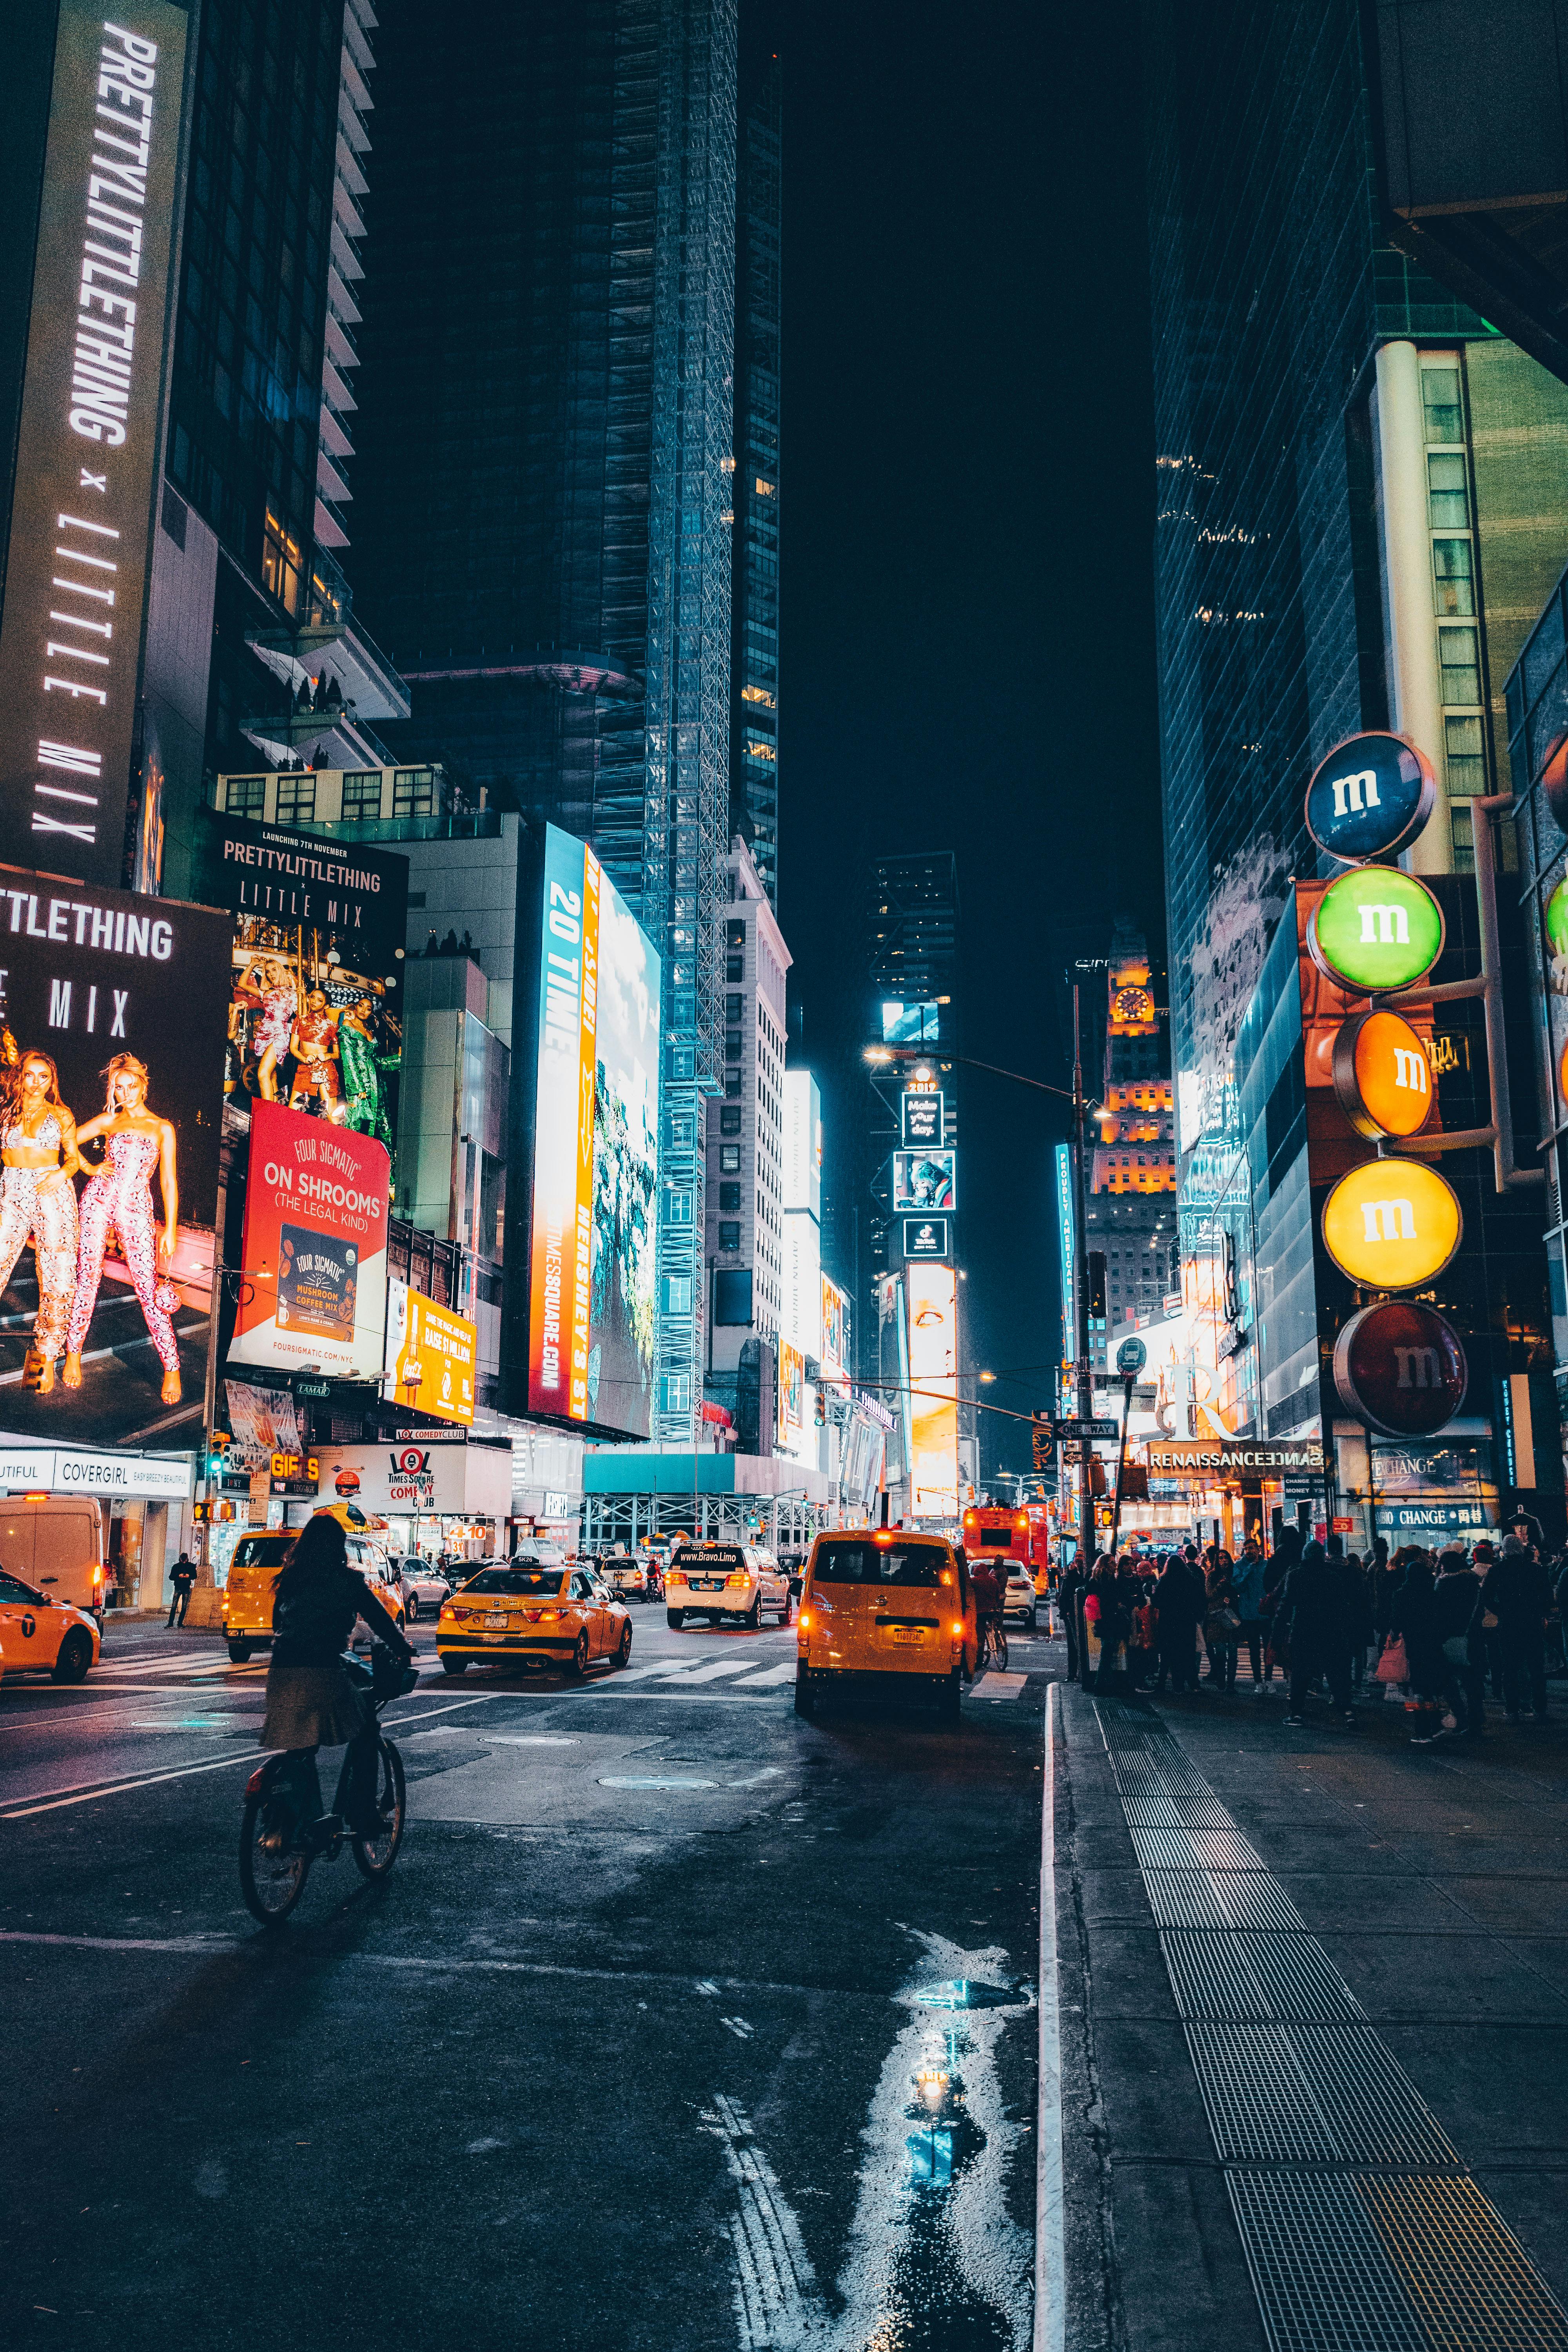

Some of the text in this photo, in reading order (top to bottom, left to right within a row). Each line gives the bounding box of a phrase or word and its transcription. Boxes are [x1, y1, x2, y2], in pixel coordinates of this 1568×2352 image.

[68, 22, 157, 446] PRETTYLITTLETHING
[44, 514, 120, 705] LITTLE
[31, 739, 101, 843] MIX
[1332, 770, 1381, 817] m
[263, 831, 347, 858] LAUNCHING 7TH NOVEMBER
[224, 840, 380, 893] PRETTYLITTLETHING
[240, 881, 361, 928] LITTLE MIX
[0, 889, 173, 960] TLETHING
[1357, 904, 1410, 945] m
[544, 880, 581, 1074] 20 TIMES
[49, 979, 128, 1038] MIX
[1393, 1047, 1426, 1094] m
[910, 1112, 935, 1125] your
[294, 1138, 316, 1163] FOUR
[264, 1162, 292, 1190] ON
[275, 1192, 368, 1234] (THE LEGAL KIND)
[1060, 1154, 1073, 1286] PROUDLY AMERICAN
[1361, 1198, 1417, 1242] m
[296, 1254, 313, 1273] FOUR
[296, 1296, 323, 1309] COFFEE
[325, 1303, 338, 1312] MIX
[297, 1285, 339, 1302] MUSHROOM
[573, 1203, 590, 1371] HERSHEY'S
[273, 1342, 353, 1363] FOURSIGMATIC.COM/NYC
[425, 1327, 442, 1352] RAISE
[449, 1340, 470, 1365] MILLION
[1393, 1346, 1442, 1388] m
[299, 1386, 327, 1396] LAMAR
[1063, 1425, 1082, 1434] ONE
[63, 1463, 128, 1485] COVERGIRL
[134, 1472, 145, 1481] EASY
[1150, 1452, 1264, 1467] RENAISSANCE
[294, 1485, 314, 1493] LUGGAGE
[413, 1497, 434, 1507] CUB
[1399, 1510, 1447, 1524] CHANGE
[681, 1552, 736, 1563] www.Bravo.Limo
